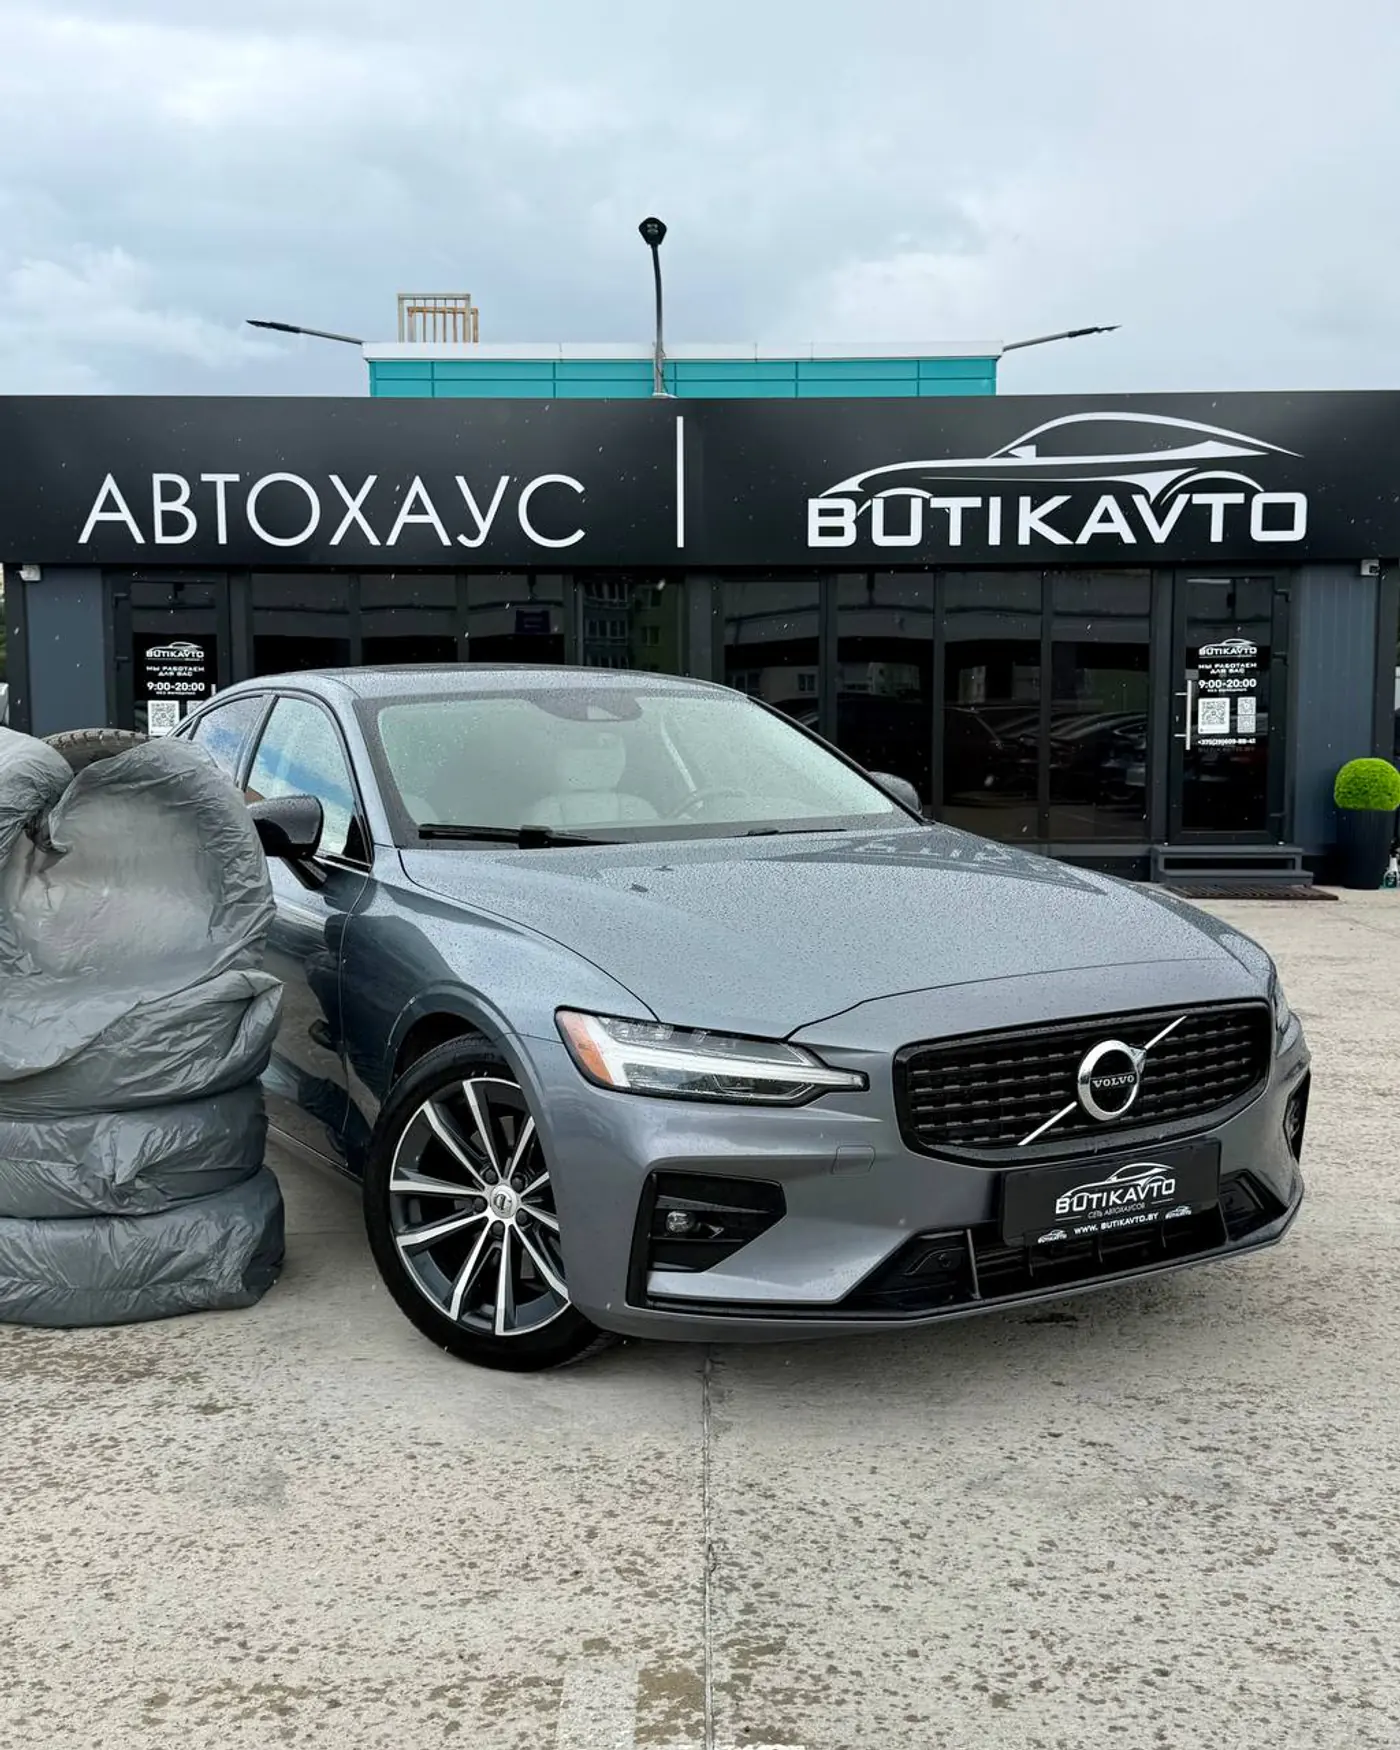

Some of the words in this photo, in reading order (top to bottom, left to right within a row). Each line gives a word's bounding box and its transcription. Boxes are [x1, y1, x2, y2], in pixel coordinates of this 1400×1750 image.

[78, 472, 586, 548] АВТОХАУС
[807, 492, 1308, 548] BUTIKAVTO
[146, 650, 205, 658] BUTIKAVTO
[1198, 646, 1257, 656] BUTIKAVTO
[147, 682, 205, 691] 9:00-20:00
[1198, 679, 1257, 689] 9:00-20:00
[1092, 1074, 1135, 1088] VOLVO
[1055, 1178, 1176, 1214] BUTIKAVTO
